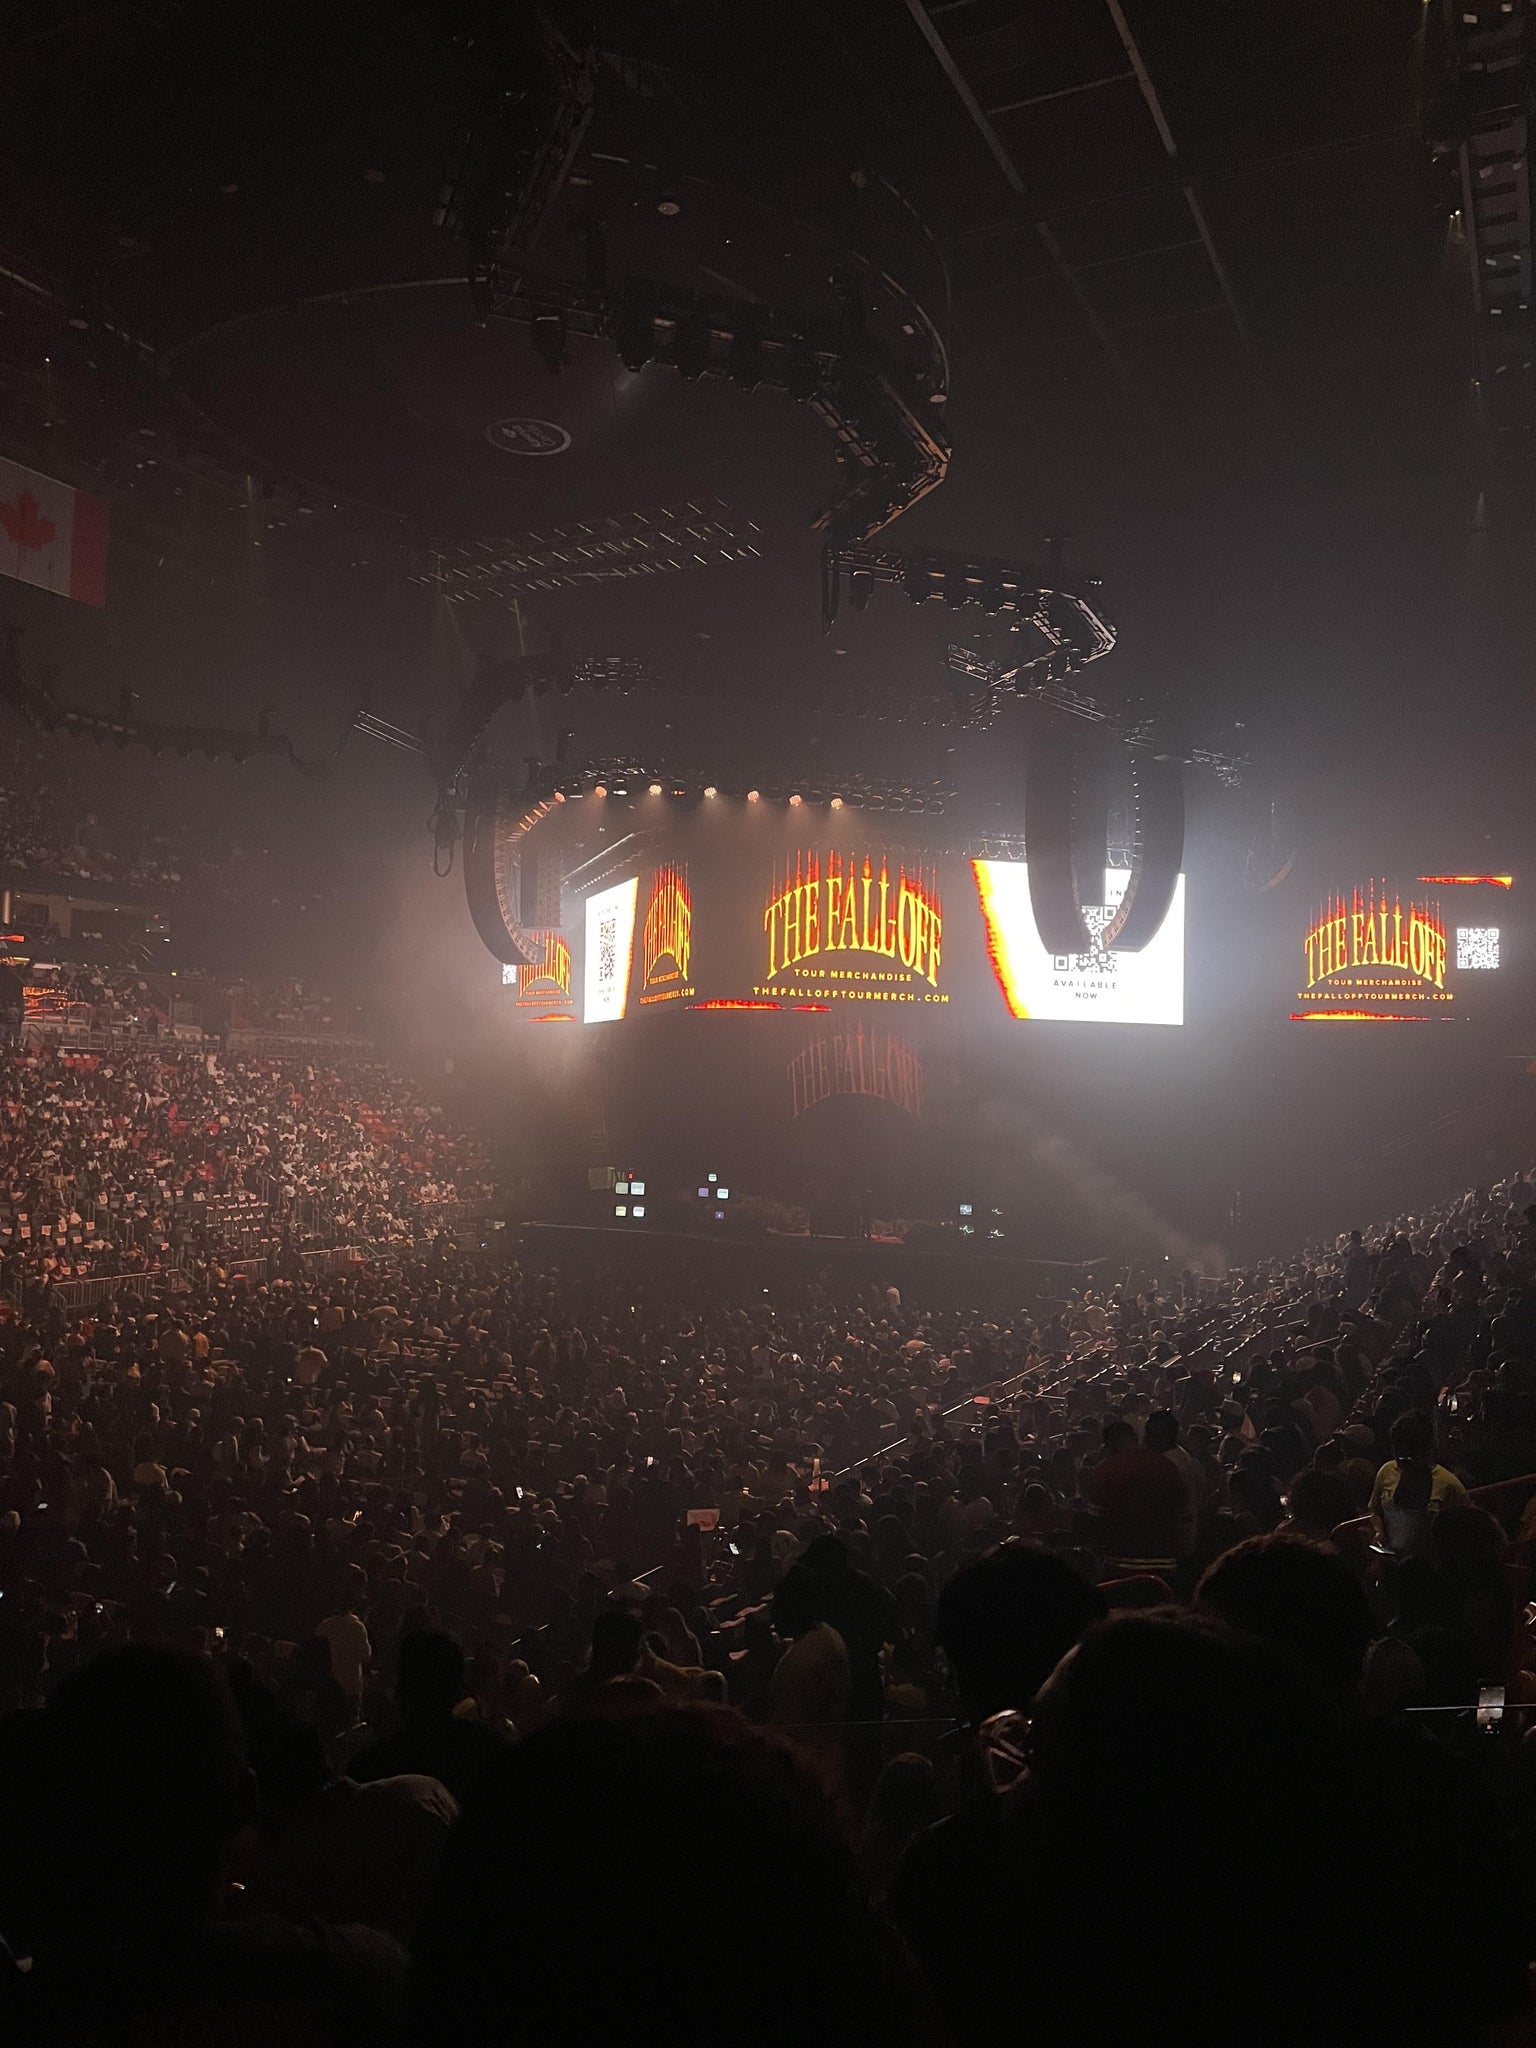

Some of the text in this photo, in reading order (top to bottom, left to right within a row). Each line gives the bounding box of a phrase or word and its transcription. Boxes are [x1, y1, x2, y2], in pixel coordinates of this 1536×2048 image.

[764, 877, 942, 988] THE FALL-OFF
[1305, 912, 1447, 990] THE FALL-OFF
[794, 968, 913, 982] TOUR MERCHANDISE
[1053, 979, 1117, 989] AVAILABLE
[753, 987, 950, 1003] THEFALLOFFTOURMERCH.COM
[1297, 992, 1454, 1000] THEFALLOFFTOURMERCH.COM
